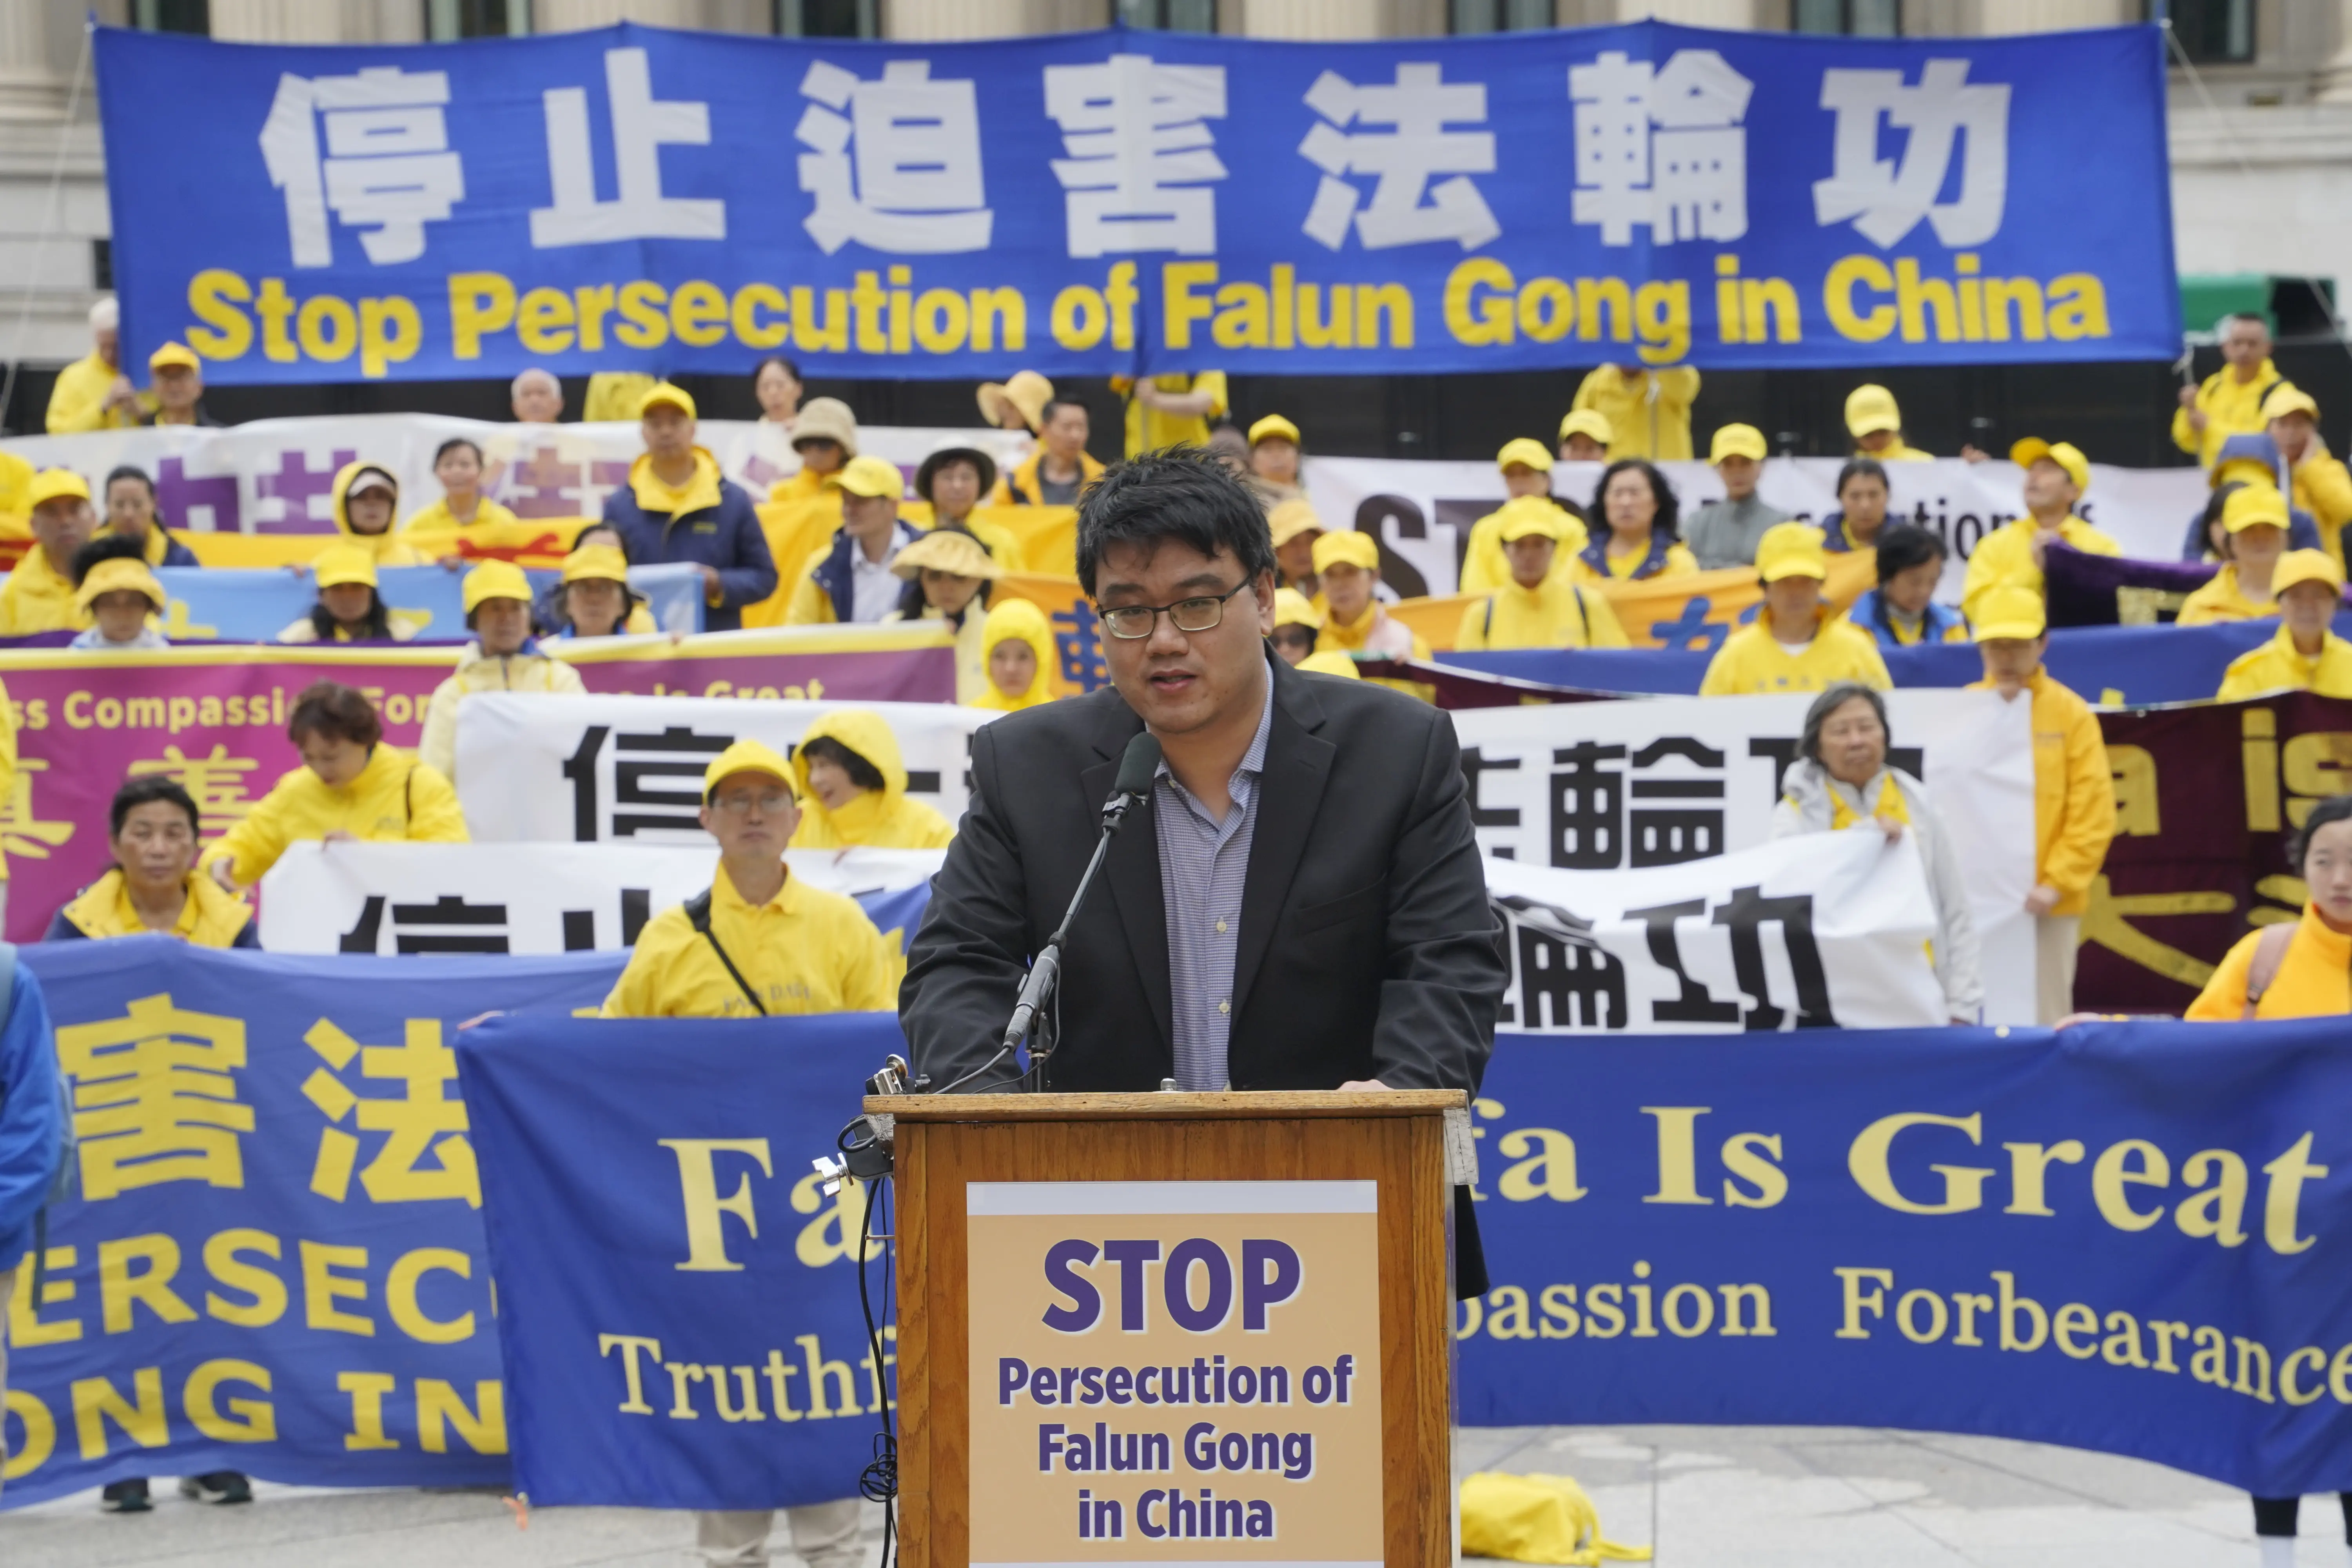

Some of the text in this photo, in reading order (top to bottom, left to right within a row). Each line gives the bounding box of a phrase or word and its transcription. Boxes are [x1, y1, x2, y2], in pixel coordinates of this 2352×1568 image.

[259, 48, 2011, 268] 停止迫害法輪功
[187, 254, 2111, 378] Stop Persecution of Falun Gong in China
[64, 687, 299, 734] Compassi
[1640, 1106, 1789, 1209] Is
[1847, 1112, 2329, 1255] Great
[1042, 1238, 1301, 1333] STOP
[337, 1371, 510, 1455] IN
[598, 1324, 897, 1423] Truthf
[998, 1354, 1353, 1406] Persecution of
[1038, 1421, 1312, 1480] Falun Gong
[1078, 1488, 1273, 1538] in China
